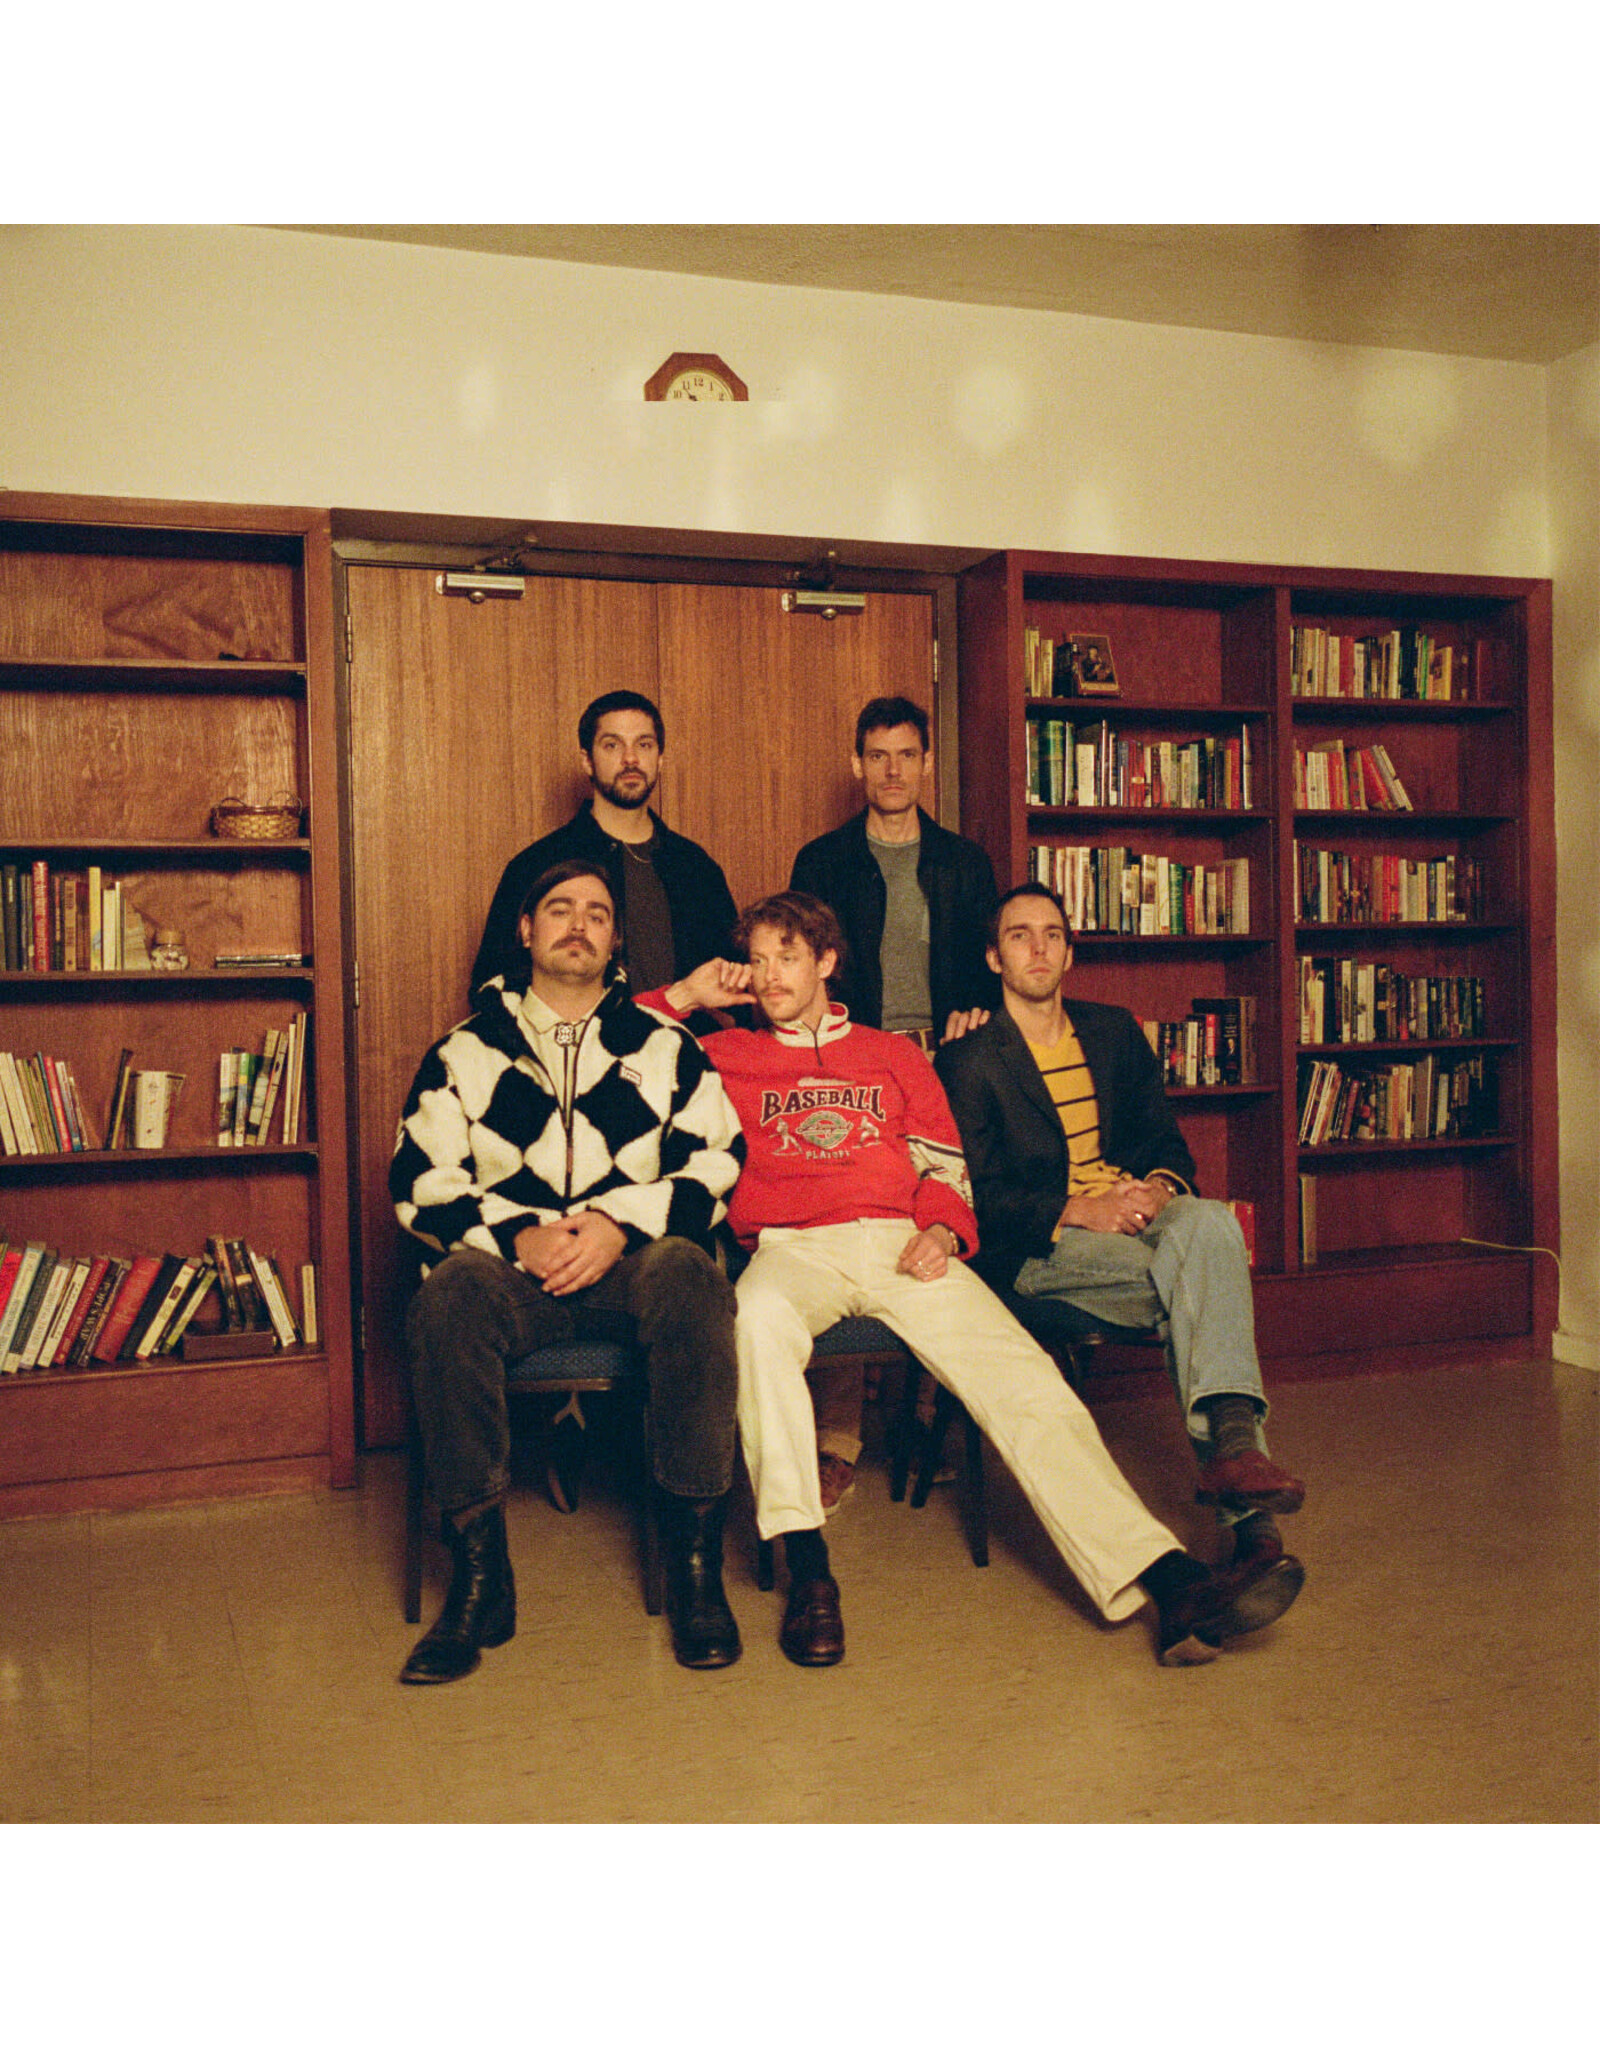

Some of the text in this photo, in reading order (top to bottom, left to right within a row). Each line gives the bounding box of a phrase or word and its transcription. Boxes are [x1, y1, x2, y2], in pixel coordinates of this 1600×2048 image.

[683, 380, 690, 390] 11
[694, 377, 704, 387] 12
[760, 1086, 886, 1126] BASEBALL
